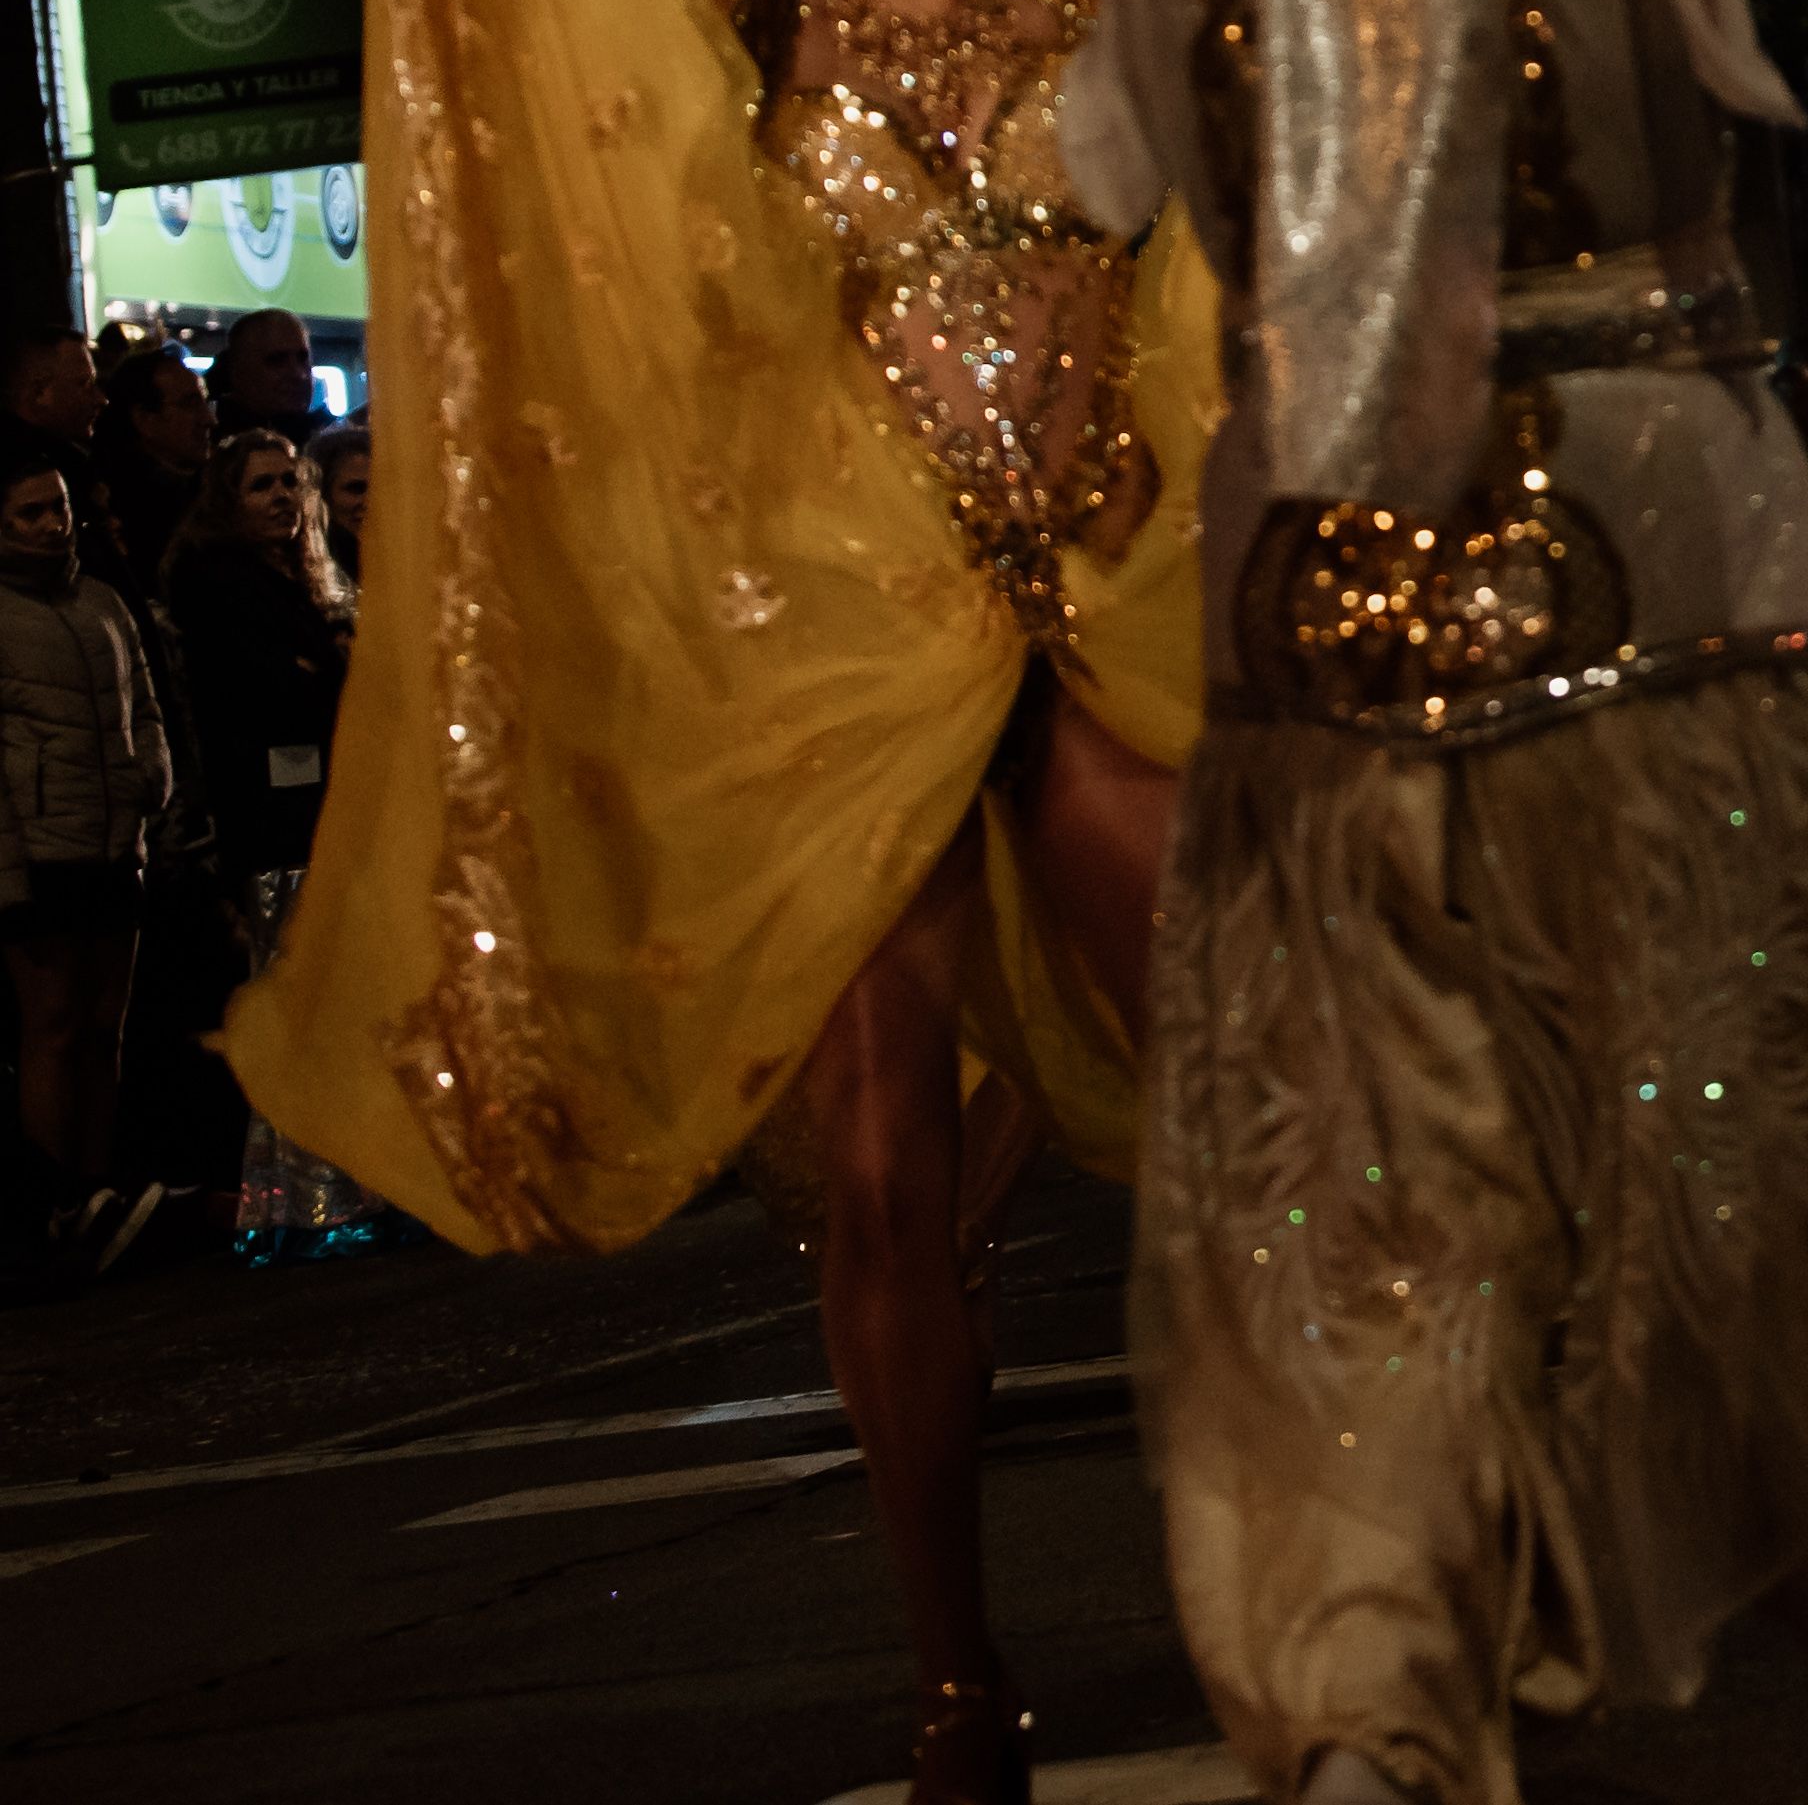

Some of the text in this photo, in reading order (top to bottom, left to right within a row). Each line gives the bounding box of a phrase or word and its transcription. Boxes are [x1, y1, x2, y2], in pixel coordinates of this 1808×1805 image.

[138, 68, 339, 110] TIENDA Y TALLER
[157, 129, 220, 165] 688
[228, 124, 271, 156] 72
[278, 117, 316, 150] 77
